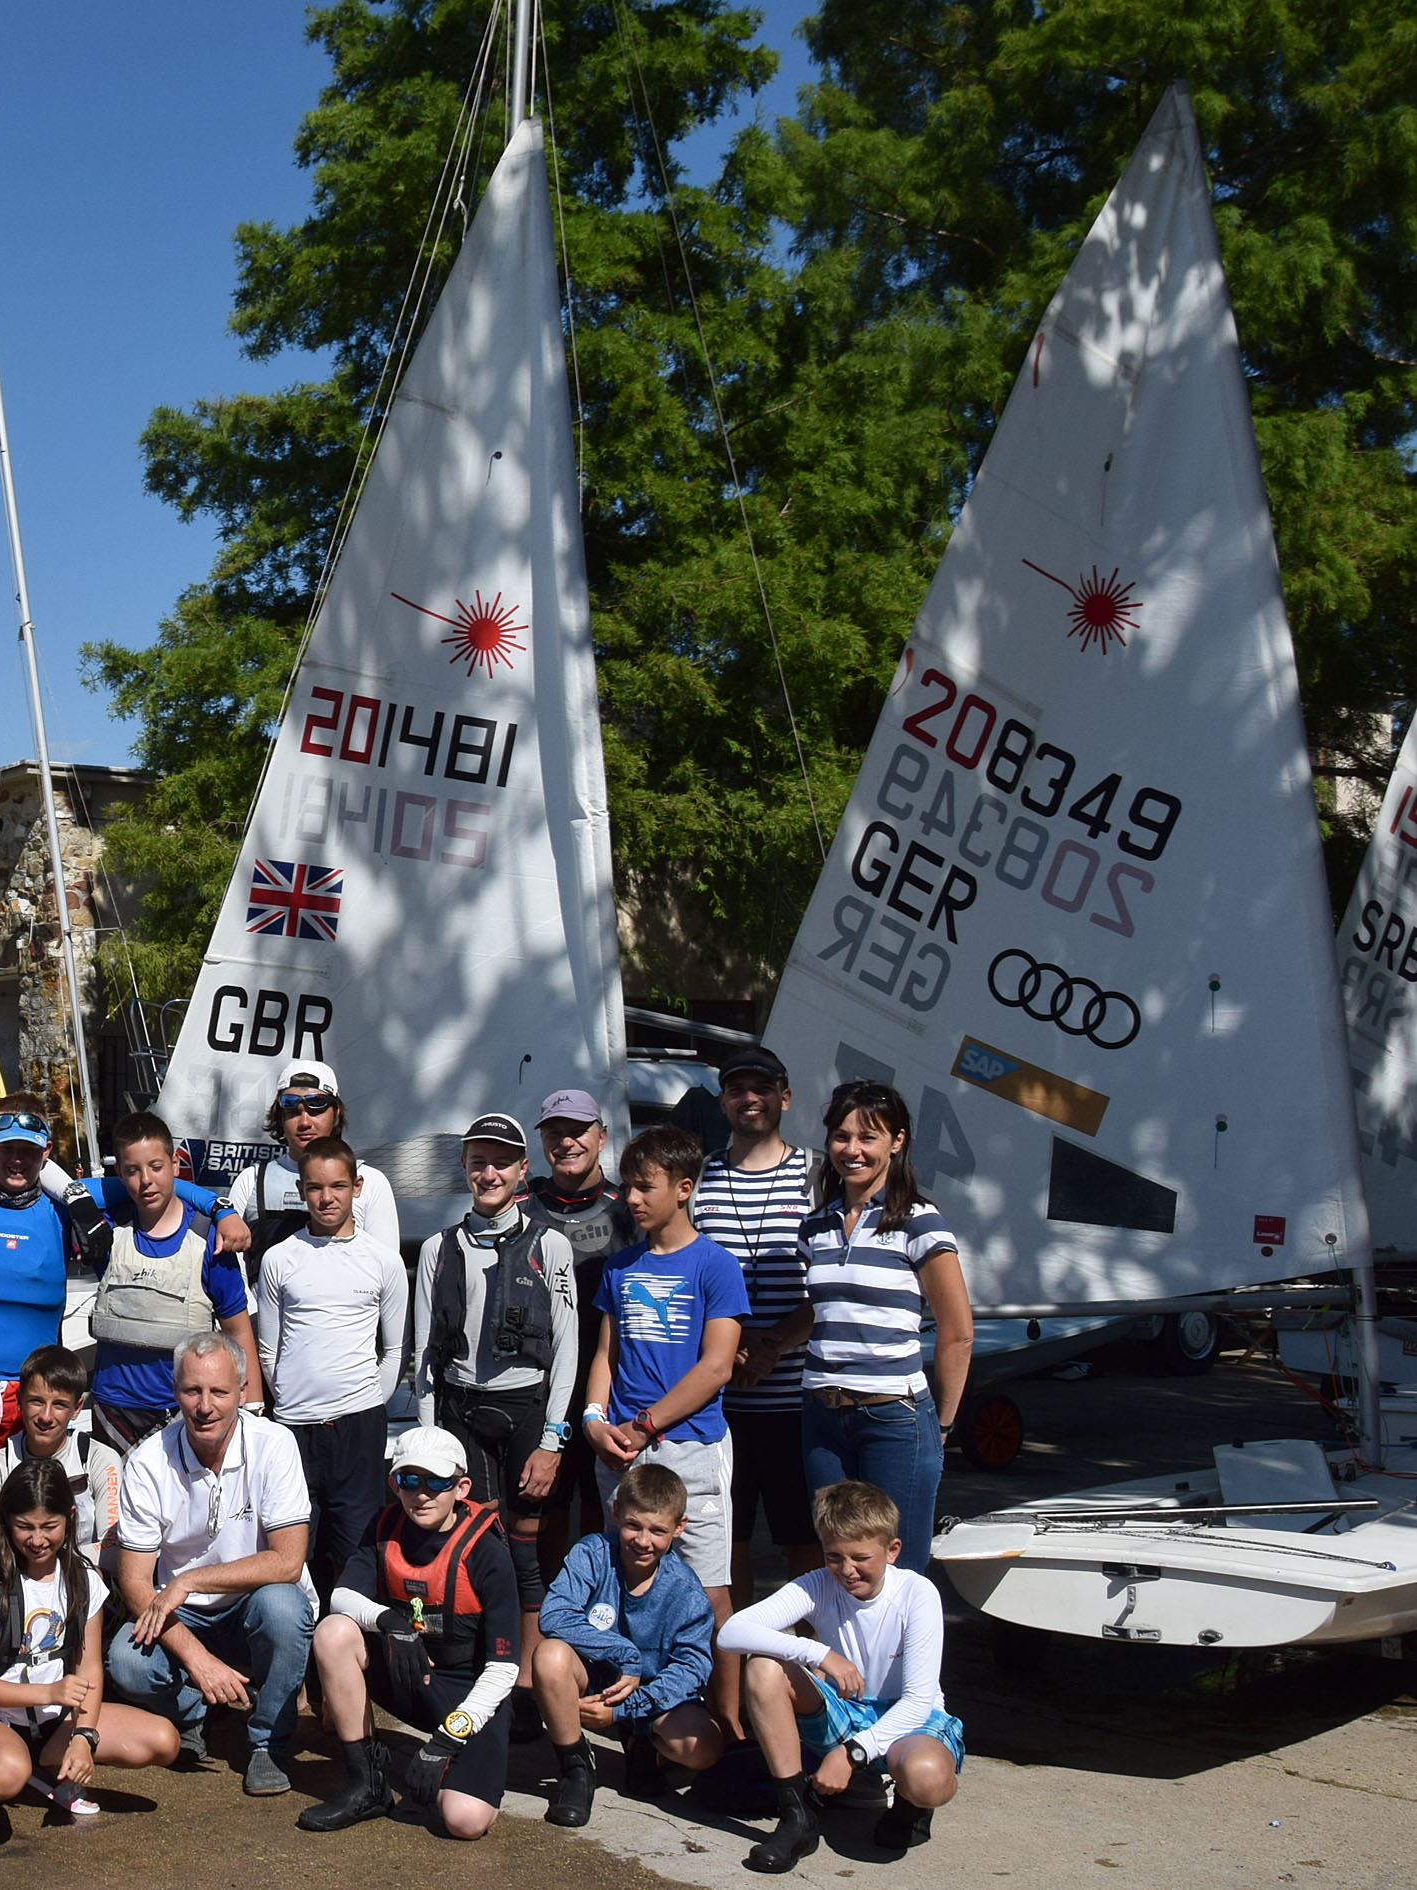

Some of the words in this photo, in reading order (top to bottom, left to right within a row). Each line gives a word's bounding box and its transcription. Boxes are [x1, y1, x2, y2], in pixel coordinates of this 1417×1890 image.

[300, 686, 518, 788] 201481
[902, 668, 1181, 861] 208349
[851, 821, 978, 944] GER
[207, 985, 334, 1062] GBR
[961, 1049, 1005, 1080] SAP
[209, 1143, 284, 1159] BRITISH
[569, 1224, 610, 1243] Gill
[515, 1277, 534, 1287] Gill
